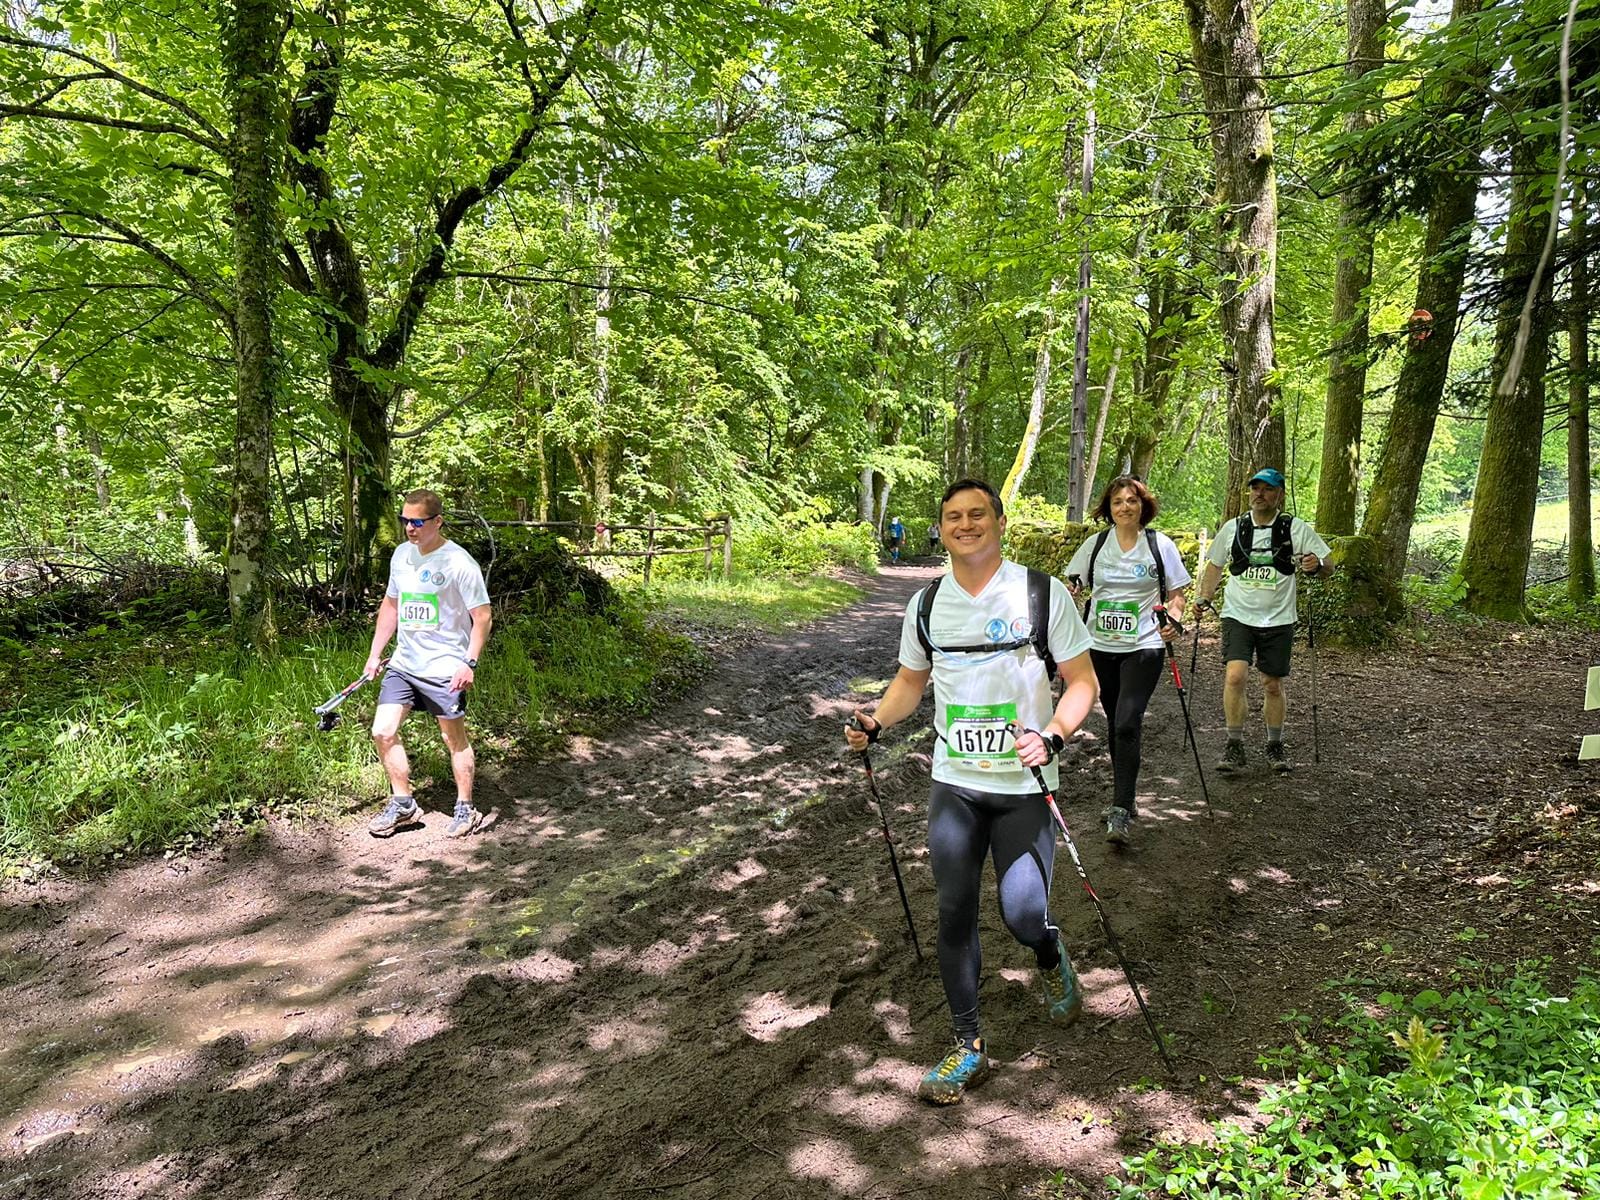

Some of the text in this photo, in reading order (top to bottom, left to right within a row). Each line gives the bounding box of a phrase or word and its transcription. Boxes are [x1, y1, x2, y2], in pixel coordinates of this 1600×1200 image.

[1245, 567, 1271, 580] 15132
[404, 606, 430, 620] 15121
[1101, 615, 1132, 631] 15075
[955, 729, 1006, 752] 15127
